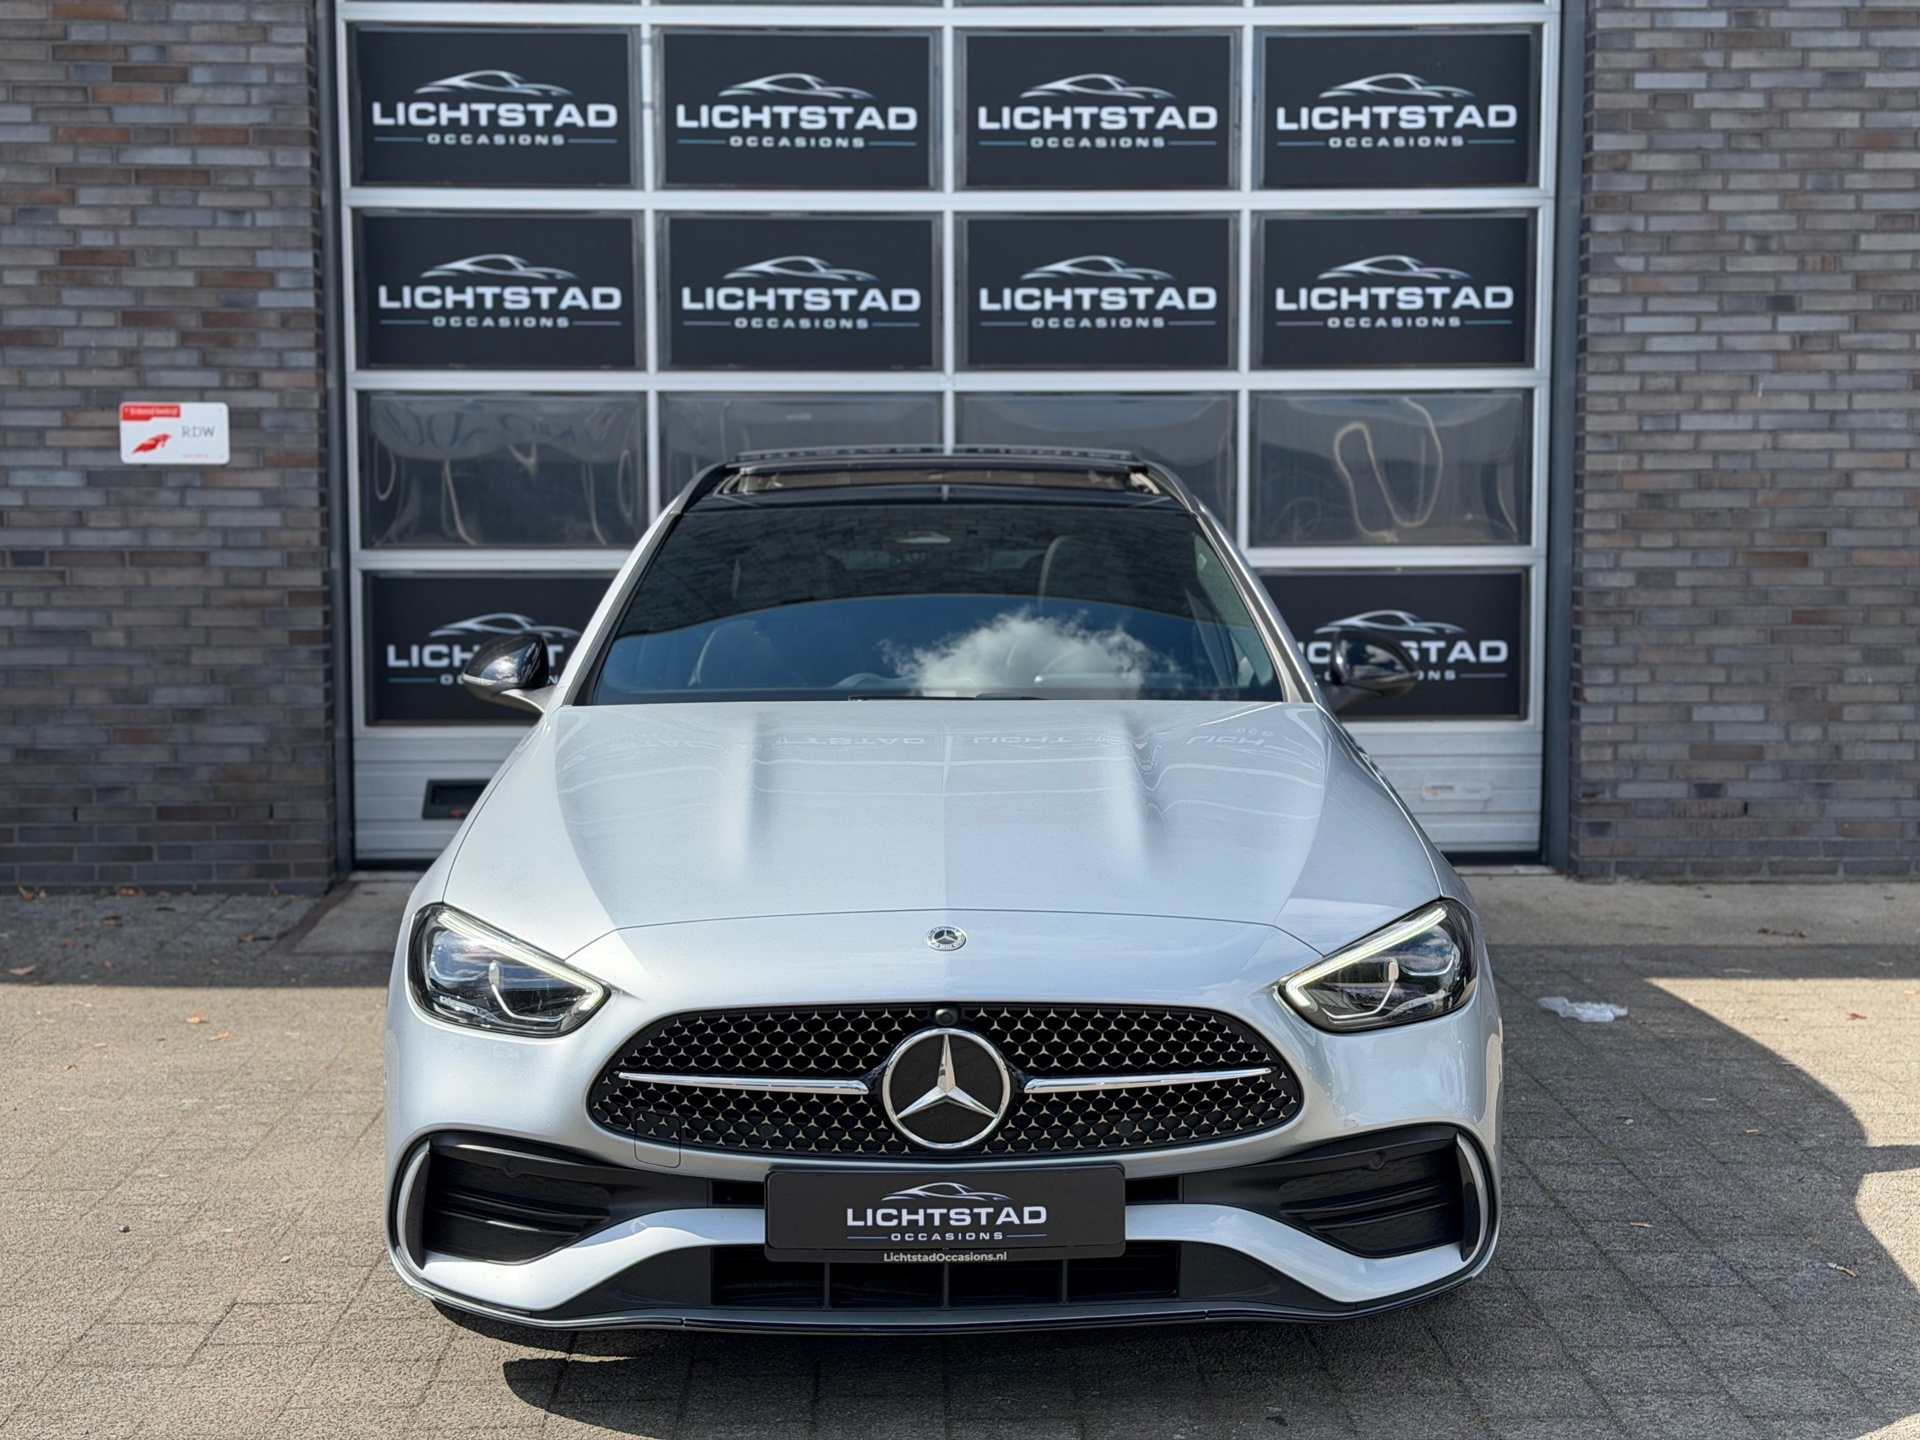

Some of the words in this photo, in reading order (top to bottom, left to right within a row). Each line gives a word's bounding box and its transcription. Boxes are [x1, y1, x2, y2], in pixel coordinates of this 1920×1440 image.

[372, 101, 618, 128] LICHTSTAD
[676, 104, 918, 131] LICHTSTAD
[978, 105, 1218, 131] LICHTSTAD
[1276, 104, 1518, 131] LICHTSTAD
[427, 133, 565, 146] OCCASIONS
[729, 135, 865, 149] OCCASIONS
[1030, 136, 1165, 148] OCCASIONS
[1328, 135, 1464, 148] OCCASIONS
[378, 285, 622, 311] LICHTSTAD
[681, 286, 921, 312] LICHTSTAD
[979, 286, 1217, 311] LICHTSTAD
[1275, 285, 1514, 311] LICHTSTAD
[432, 315, 570, 328] OCCASIONS
[734, 317, 869, 330] OCCASIONS
[1031, 316, 1165, 329] OCCASIONS
[1326, 316, 1461, 329] OCCASIONS
[181, 426, 215, 438] RDW
[386, 644, 564, 668] LICHT
[846, 1205, 1047, 1227] LICHTSTAD
[890, 1231, 1003, 1242] OCCASIONS
[883, 1251, 1007, 1263] LichtstadOccasions.nl
